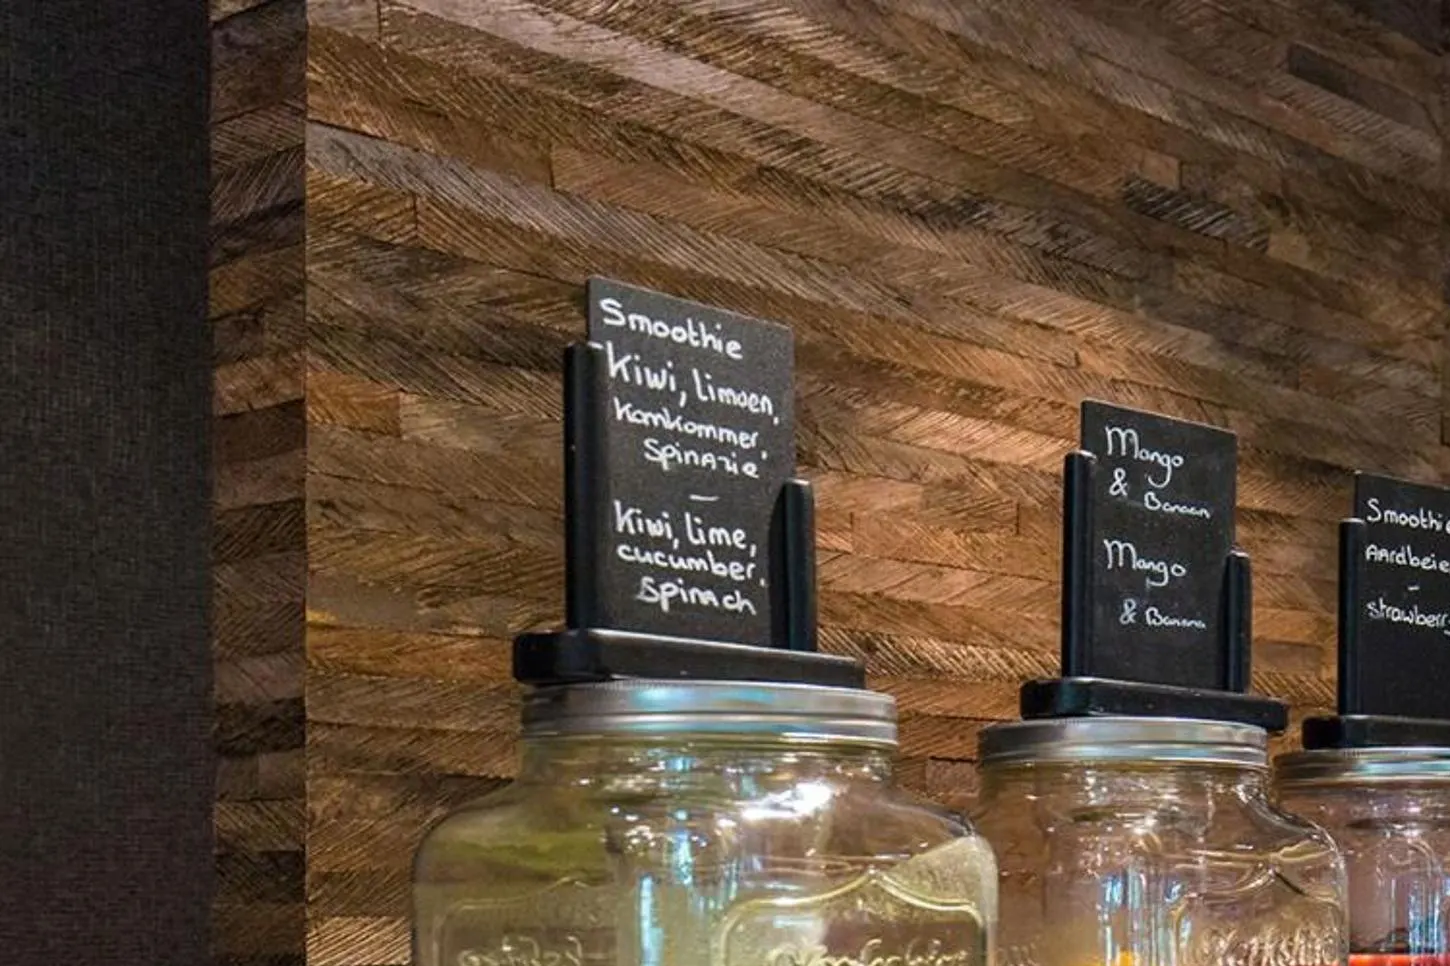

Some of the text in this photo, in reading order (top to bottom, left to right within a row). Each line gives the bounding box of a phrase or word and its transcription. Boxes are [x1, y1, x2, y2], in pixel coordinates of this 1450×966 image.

[600, 298, 743, 360] Smoothie
[1104, 426, 1184, 488] Mango
[1103, 539, 1187, 587] Mango
